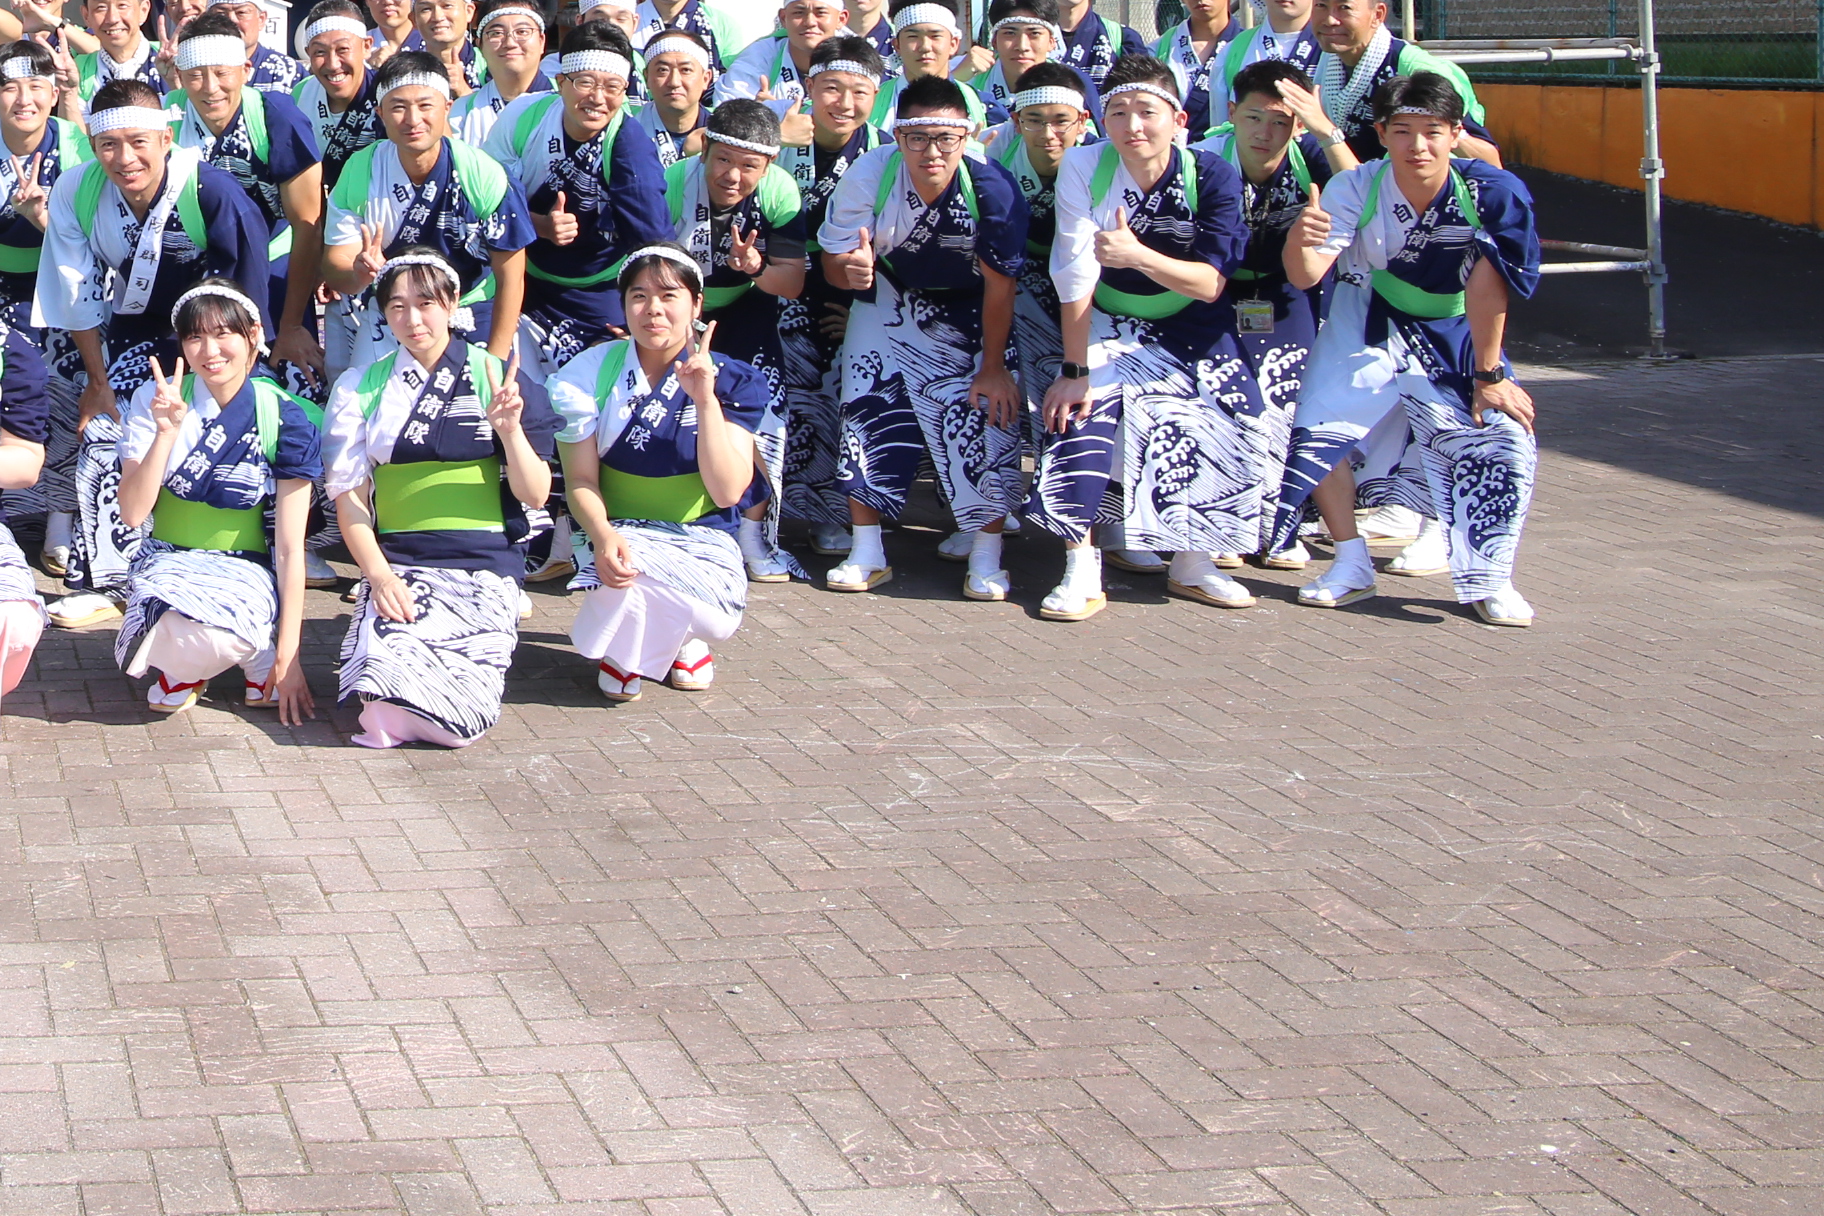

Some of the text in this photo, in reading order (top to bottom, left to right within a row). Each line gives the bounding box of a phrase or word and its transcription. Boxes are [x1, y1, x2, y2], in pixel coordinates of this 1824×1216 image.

[327, 110, 359, 161] 自衛隊
[544, 142, 591, 192] 自衛隊
[802, 156, 850, 211] 自衛隊
[399, 181, 438, 244] 自衛隊
[693, 204, 712, 264] 自衛隊
[900, 208, 940, 254] 自衛隊
[1128, 191, 1162, 234] 自衛
[1396, 206, 1439, 264] 自衛隊
[403, 366, 455, 445] 自衛隊
[624, 373, 679, 451] 自衛隊
[167, 424, 228, 498] 自衛隊
